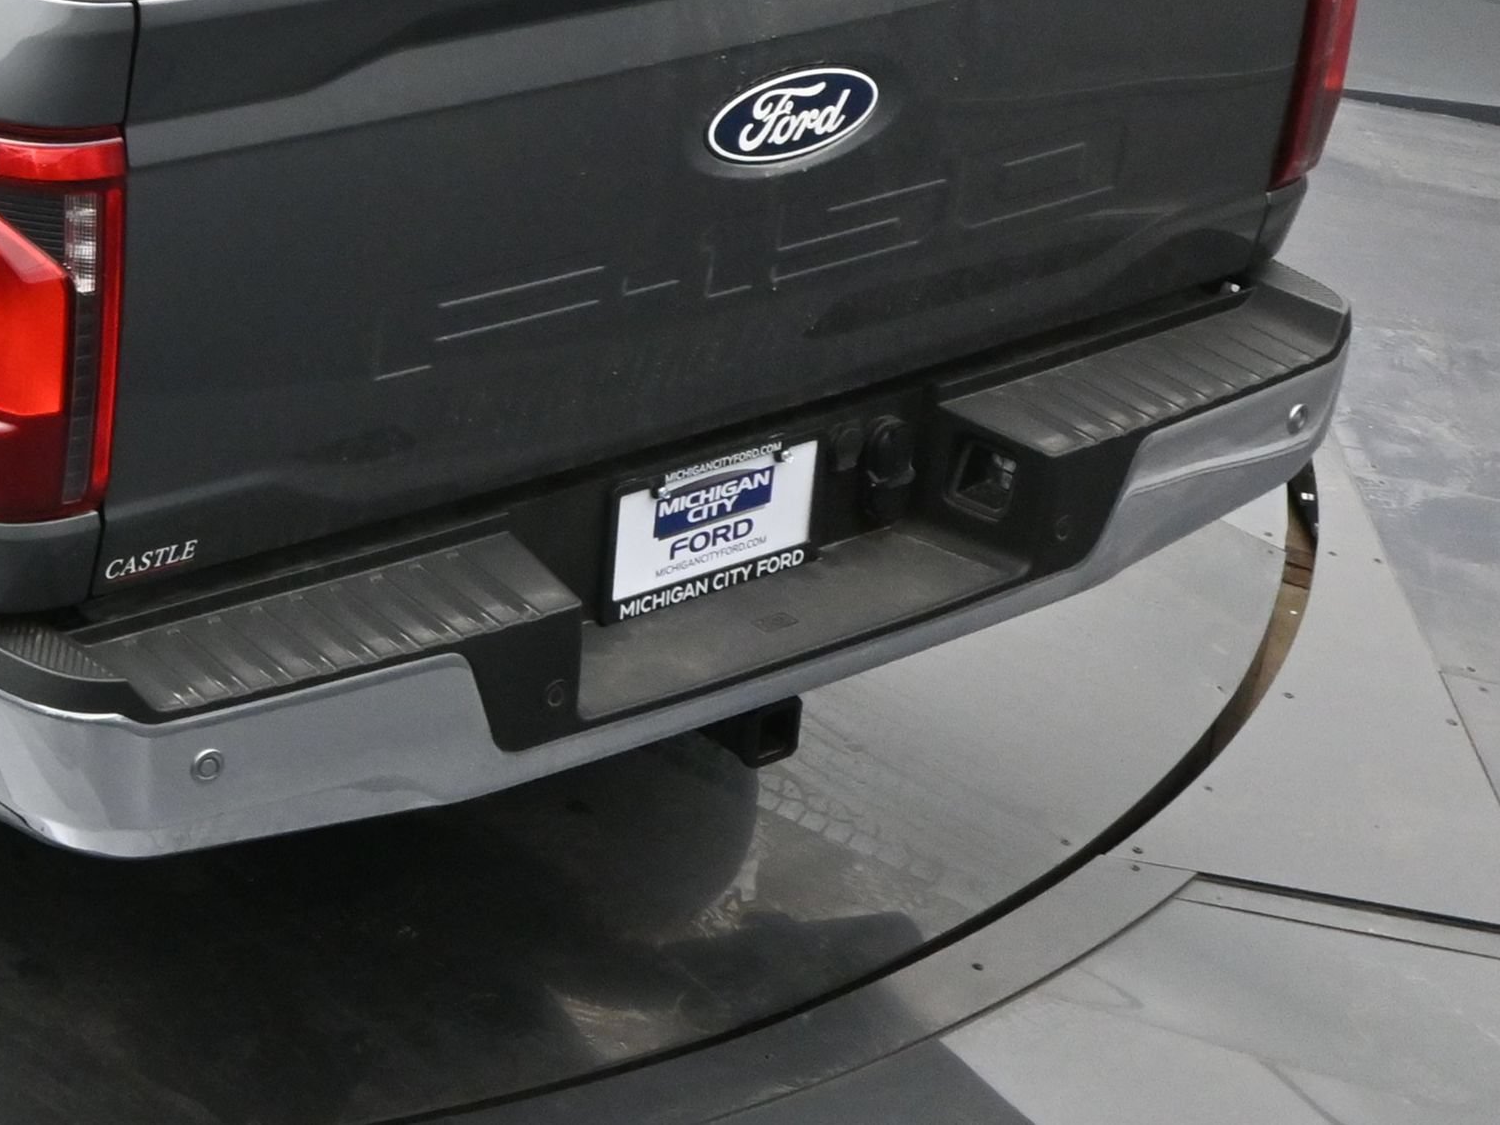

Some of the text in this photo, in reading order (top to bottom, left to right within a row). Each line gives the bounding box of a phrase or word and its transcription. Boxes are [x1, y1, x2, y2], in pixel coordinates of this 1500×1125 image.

[738, 81, 851, 152] Ford
[664, 441, 783, 483] MICHIGANCITYFORD.COM
[658, 470, 771, 518] MICHIGAN
[687, 495, 739, 524] CITY
[105, 539, 198, 580] CASTLE
[655, 535, 767, 577] MICHIGANCITYFORD.COM
[669, 518, 754, 560] FORD
[619, 549, 805, 620] MICHIGAN CITY FORD
